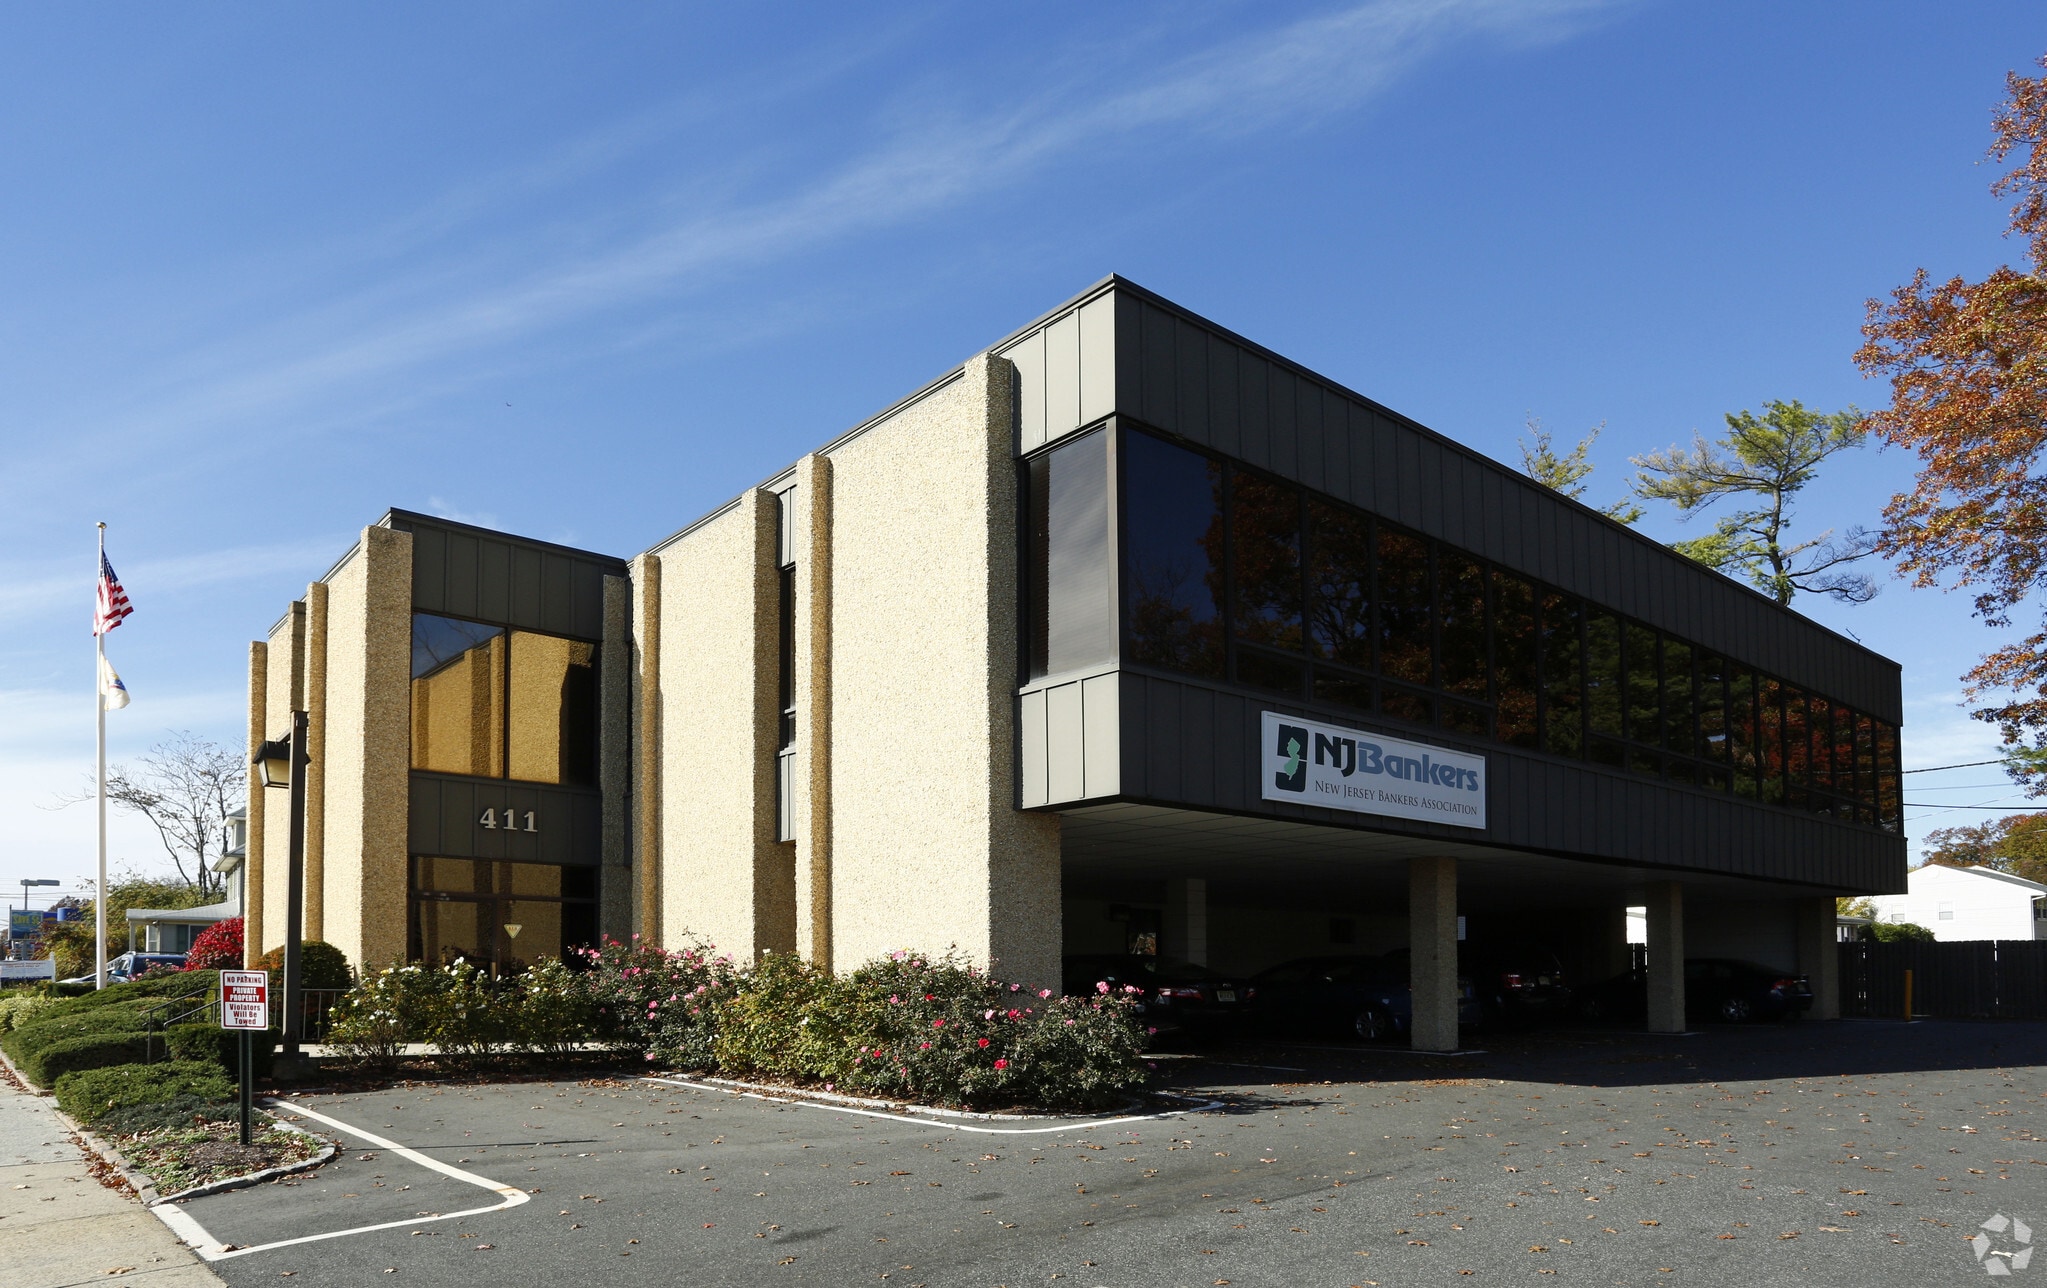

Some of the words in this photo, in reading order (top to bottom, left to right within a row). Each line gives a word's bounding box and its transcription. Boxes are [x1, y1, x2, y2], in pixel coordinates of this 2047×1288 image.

[1315, 780, 1340, 795] NEW
[1343, 785, 1376, 800] JERSEY
[1378, 790, 1419, 807] BANKERS
[1420, 798, 1478, 815] ASSOCIATION
[480, 808, 538, 833] 411
